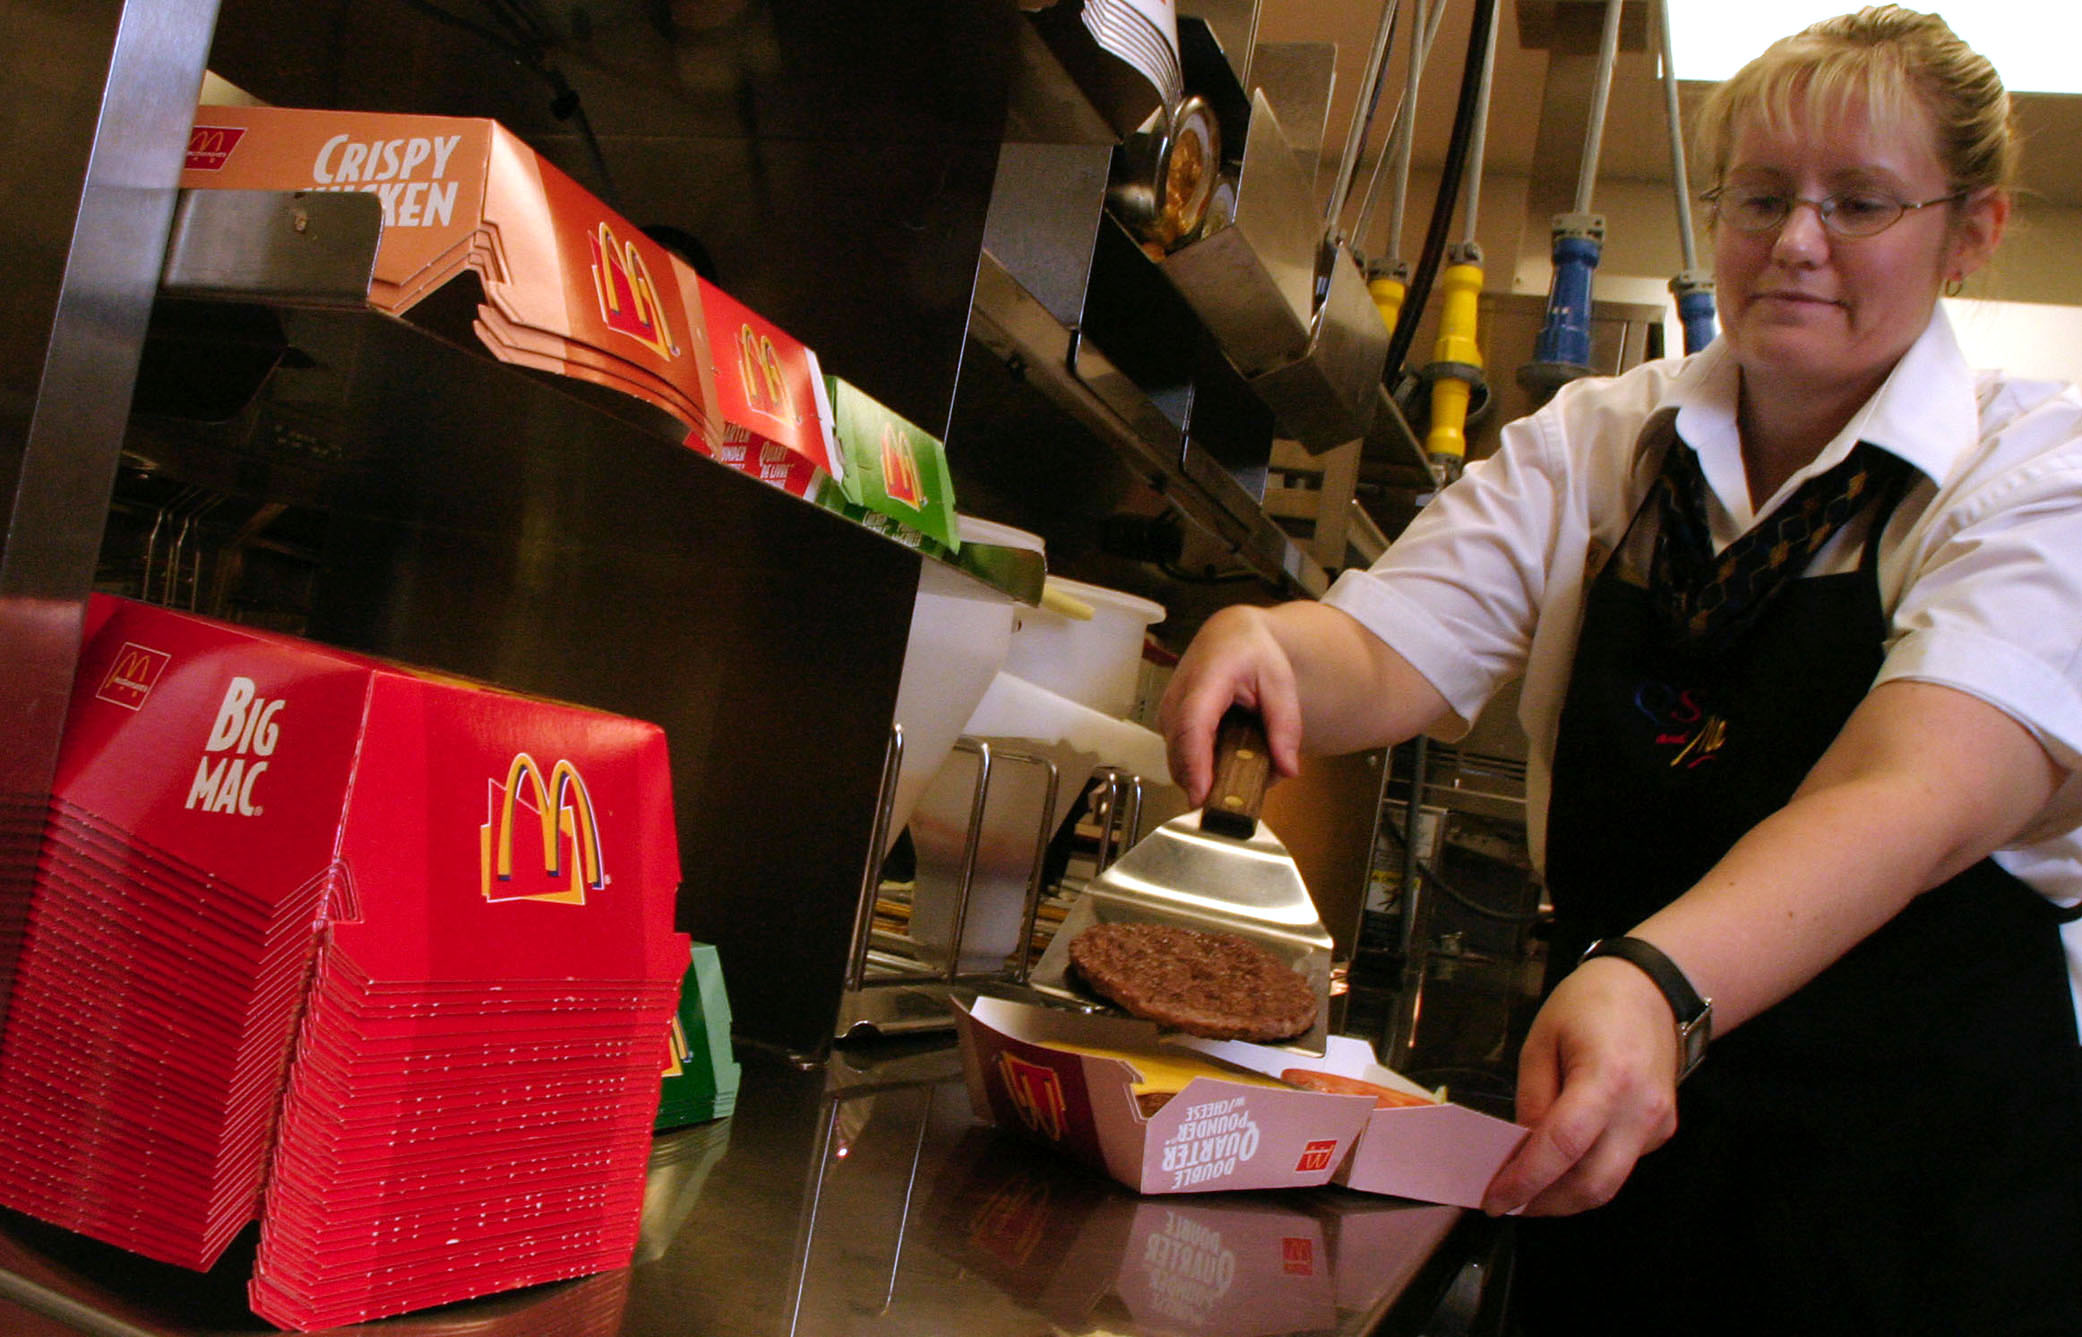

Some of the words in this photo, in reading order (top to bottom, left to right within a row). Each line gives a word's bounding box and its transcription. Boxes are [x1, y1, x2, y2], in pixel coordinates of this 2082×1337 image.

[312, 133, 462, 185] CRISPY
[205, 676, 287, 757] BIG
[184, 755, 269, 817] MAC
[1161, 1121, 1260, 1172] QUARTER
[1177, 1110, 1249, 1143] POUNDER
[1171, 1156, 1237, 1190] DOUBLE
